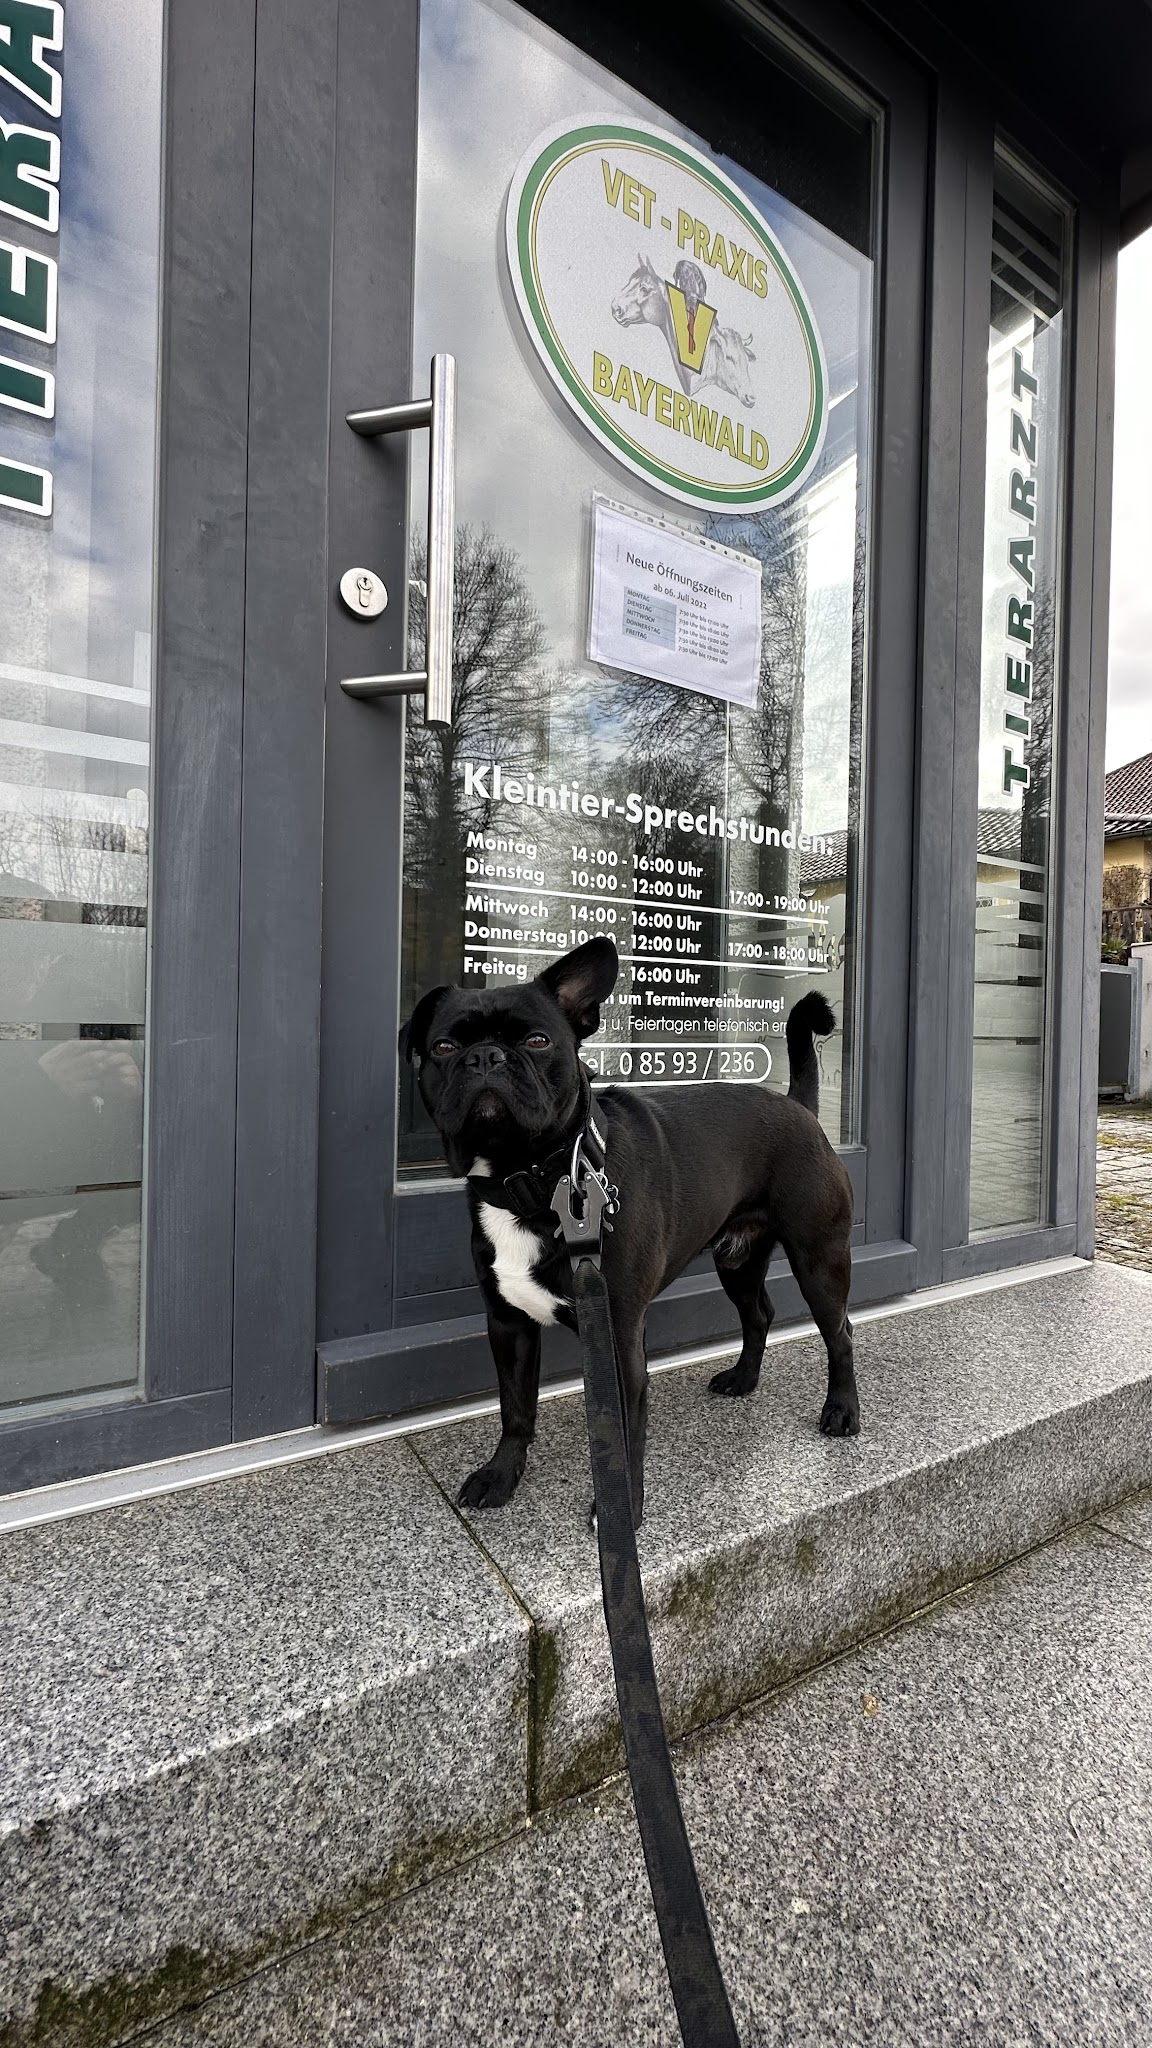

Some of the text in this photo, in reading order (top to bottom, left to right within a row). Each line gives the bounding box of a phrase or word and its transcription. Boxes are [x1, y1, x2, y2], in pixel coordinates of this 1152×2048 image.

[601, 158, 656, 229] VET
[677, 208, 768, 299] PRAXIS
[592, 351, 769, 470] BAYERWALD
[626, 551, 654, 572] Neue
[656, 561, 733, 603] Öffnungszeiten
[1001, 346, 1038, 797] TIERARZT
[627, 590, 650, 602] MONTAG
[690, 612, 698, 620] Uhr
[699, 615, 707, 623] bis
[653, 583, 707, 609] ab 06. Juli 2022
[627, 599, 653, 613] DIENSTAG
[690, 621, 698, 629] Uhr
[699, 624, 707, 632] bis
[627, 609, 655, 623] MITTWOCH
[690, 630, 698, 638] Uhr
[699, 633, 707, 641] bis
[720, 639, 729, 647] Uhr
[625, 627, 648, 640] FREITAG
[689, 648, 698, 656] Uhr
[698, 651, 706, 659] bis
[719, 657, 728, 665] Uhr
[626, 618, 661, 635] DONNERSTAG
[689, 639, 698, 647] Uhr
[699, 642, 707, 650] bis
[720, 648, 729, 656] Uhr
[464, 762, 833, 856] Kleintier-Sprechstunden:
[466, 831, 537, 860] Montag
[571, 845, 618, 867] 14:00
[632, 854, 674, 875] 16:00
[677, 860, 704, 878] Uhr
[465, 857, 545, 886] Dienstag
[571, 870, 618, 891] 10:00
[632, 877, 674, 897] 12:00
[677, 883, 703, 900] Uhr
[729, 889, 764, 907] 17:00
[774, 895, 807, 912] 19:00
[809, 899, 830, 914] Uhr
[465, 894, 549, 918] Mittwoch
[570, 905, 617, 924] 14:00
[631, 911, 673, 929] 16:00
[676, 915, 702, 931] Uhr
[464, 921, 568, 948] Donnerstag
[631, 934, 672, 952] 12:00
[676, 937, 702, 954] Uhr
[728, 942, 763, 959] 17:00
[773, 945, 806, 962] 18:00
[808, 949, 830, 963] Uhr
[463, 957, 528, 978] Freitag
[630, 966, 672, 983] 16:00
[675, 968, 701, 984] Uhr
[618, 994, 642, 1005] um
[645, 990, 785, 1013] Terminvereinbarung!
[611, 1018, 624, 1031] u.
[628, 1015, 701, 1035] Feiertagen
[703, 1016, 769, 1032] telefonisch
[619, 1052, 633, 1075] 0
[639, 1051, 666, 1075] 85
[672, 1051, 698, 1074] 93
[702, 1050, 713, 1080] /
[719, 1051, 755, 1073] 236
